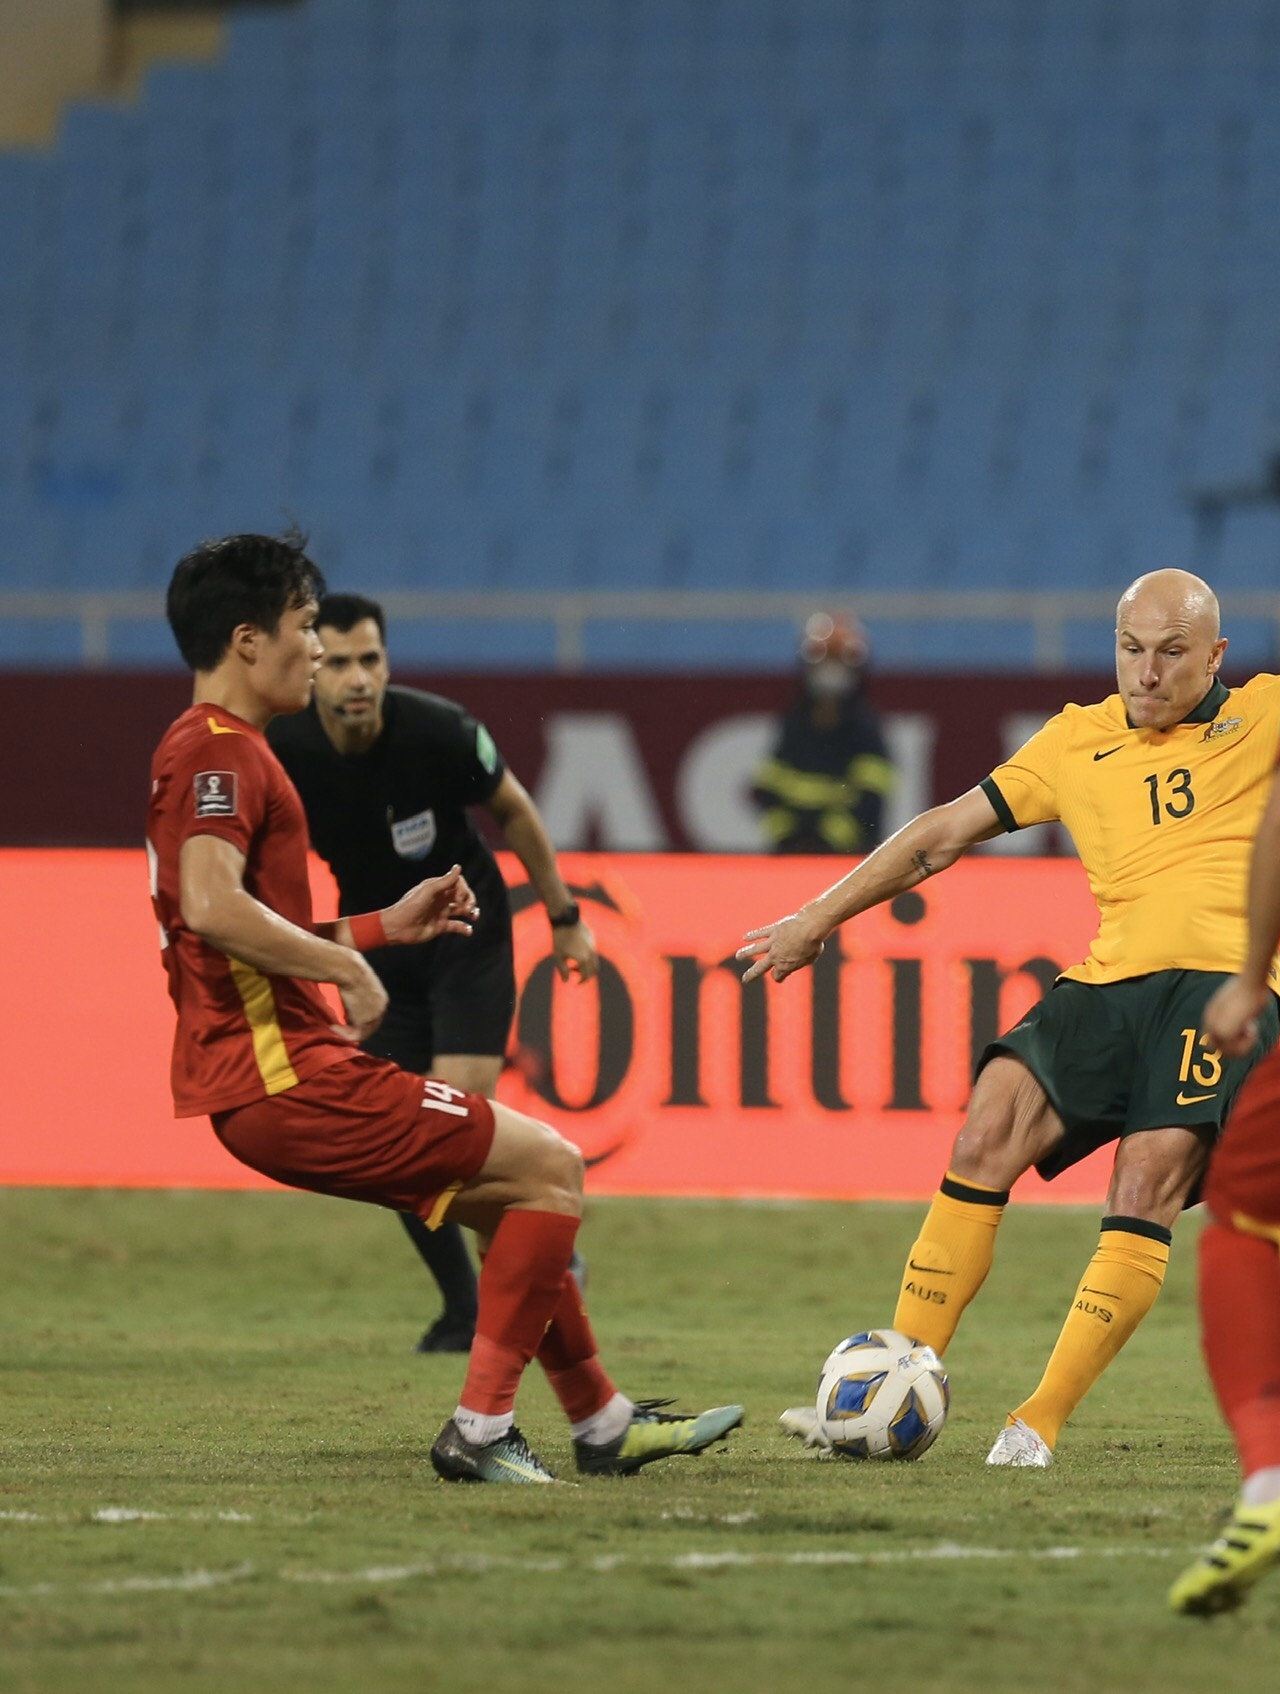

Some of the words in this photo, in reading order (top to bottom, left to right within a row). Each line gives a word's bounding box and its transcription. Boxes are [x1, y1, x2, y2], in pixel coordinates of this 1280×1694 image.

[1144, 768, 1195, 825] 13
[1179, 1028, 1222, 1087] 13
[421, 1080, 469, 1117] 14
[905, 1281, 947, 1305] AUS
[1074, 1300, 1113, 1323] AUS
